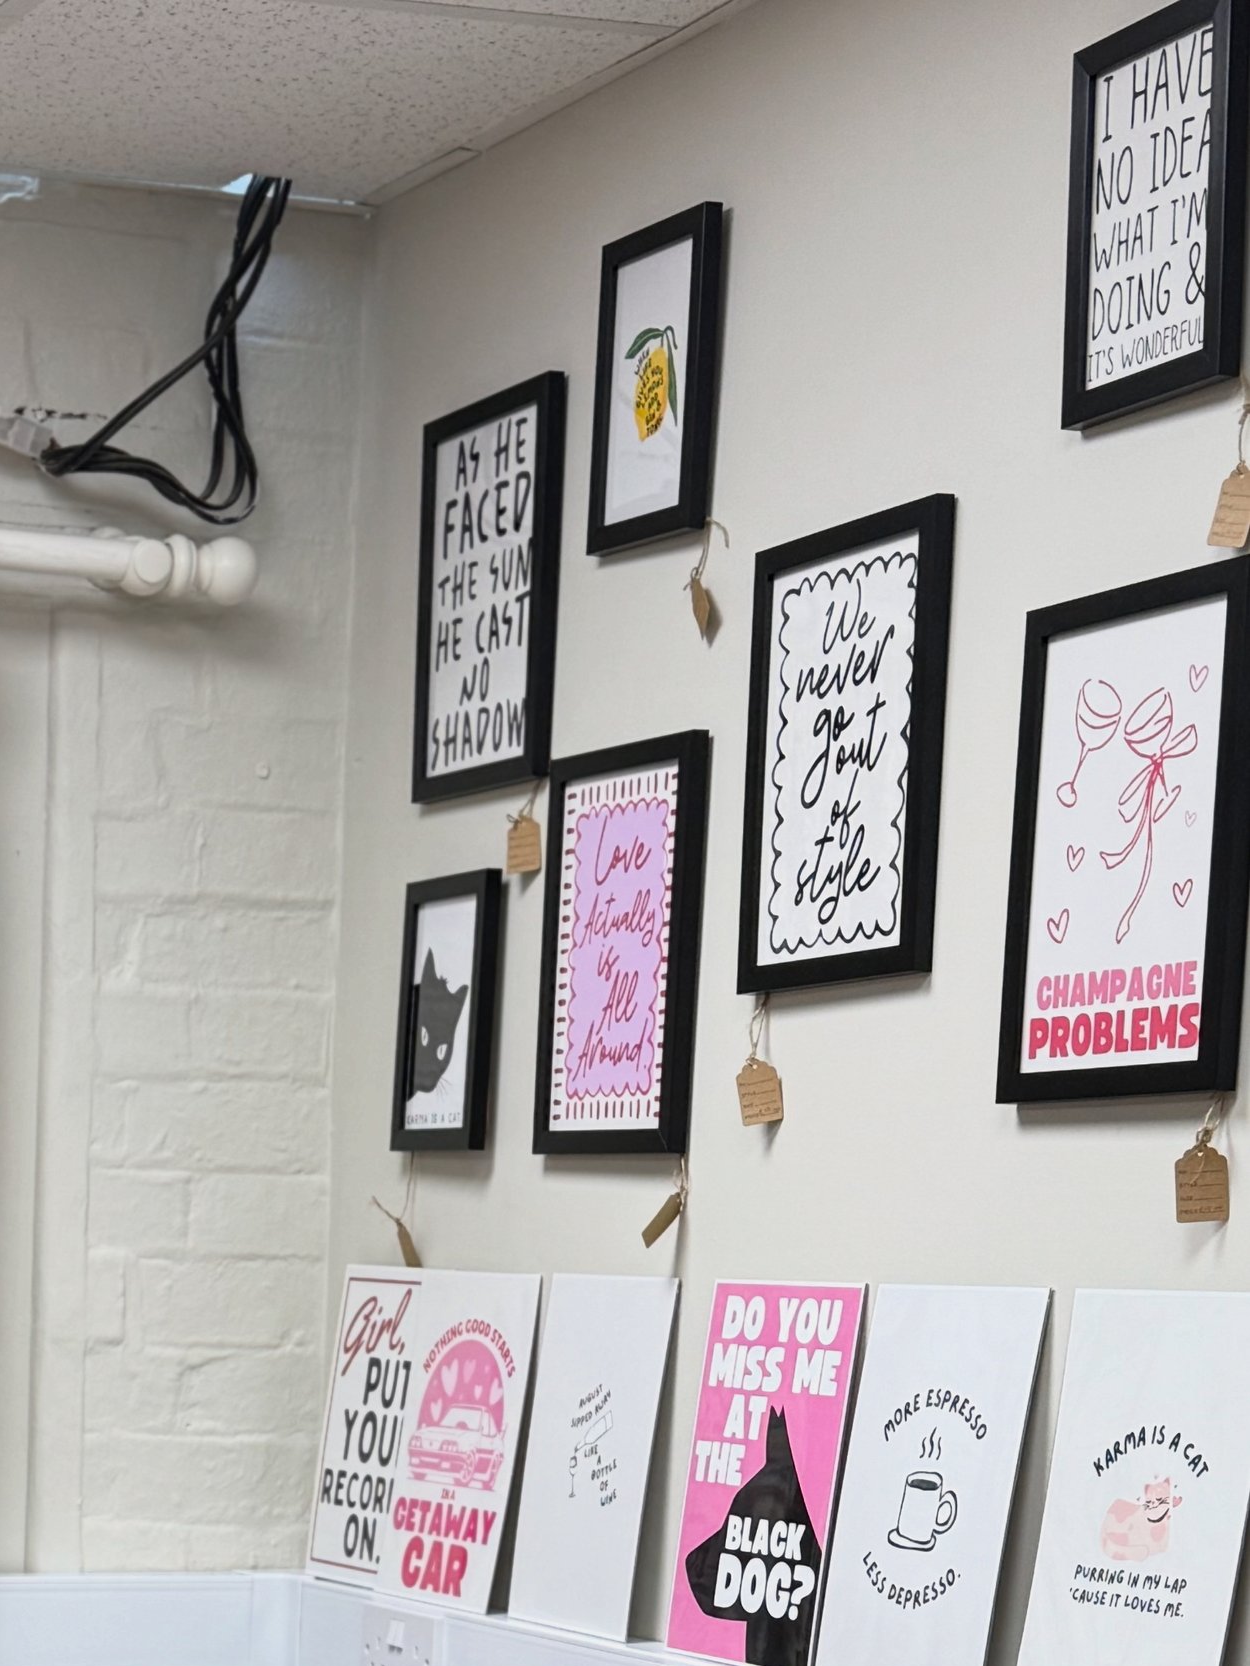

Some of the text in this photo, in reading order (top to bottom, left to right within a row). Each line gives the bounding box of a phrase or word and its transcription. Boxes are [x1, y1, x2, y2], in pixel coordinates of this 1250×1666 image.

[1102, 27, 1213, 143] I HAVE
[1096, 107, 1211, 215] NO IDEA
[1093, 188, 1207, 273] WHAT I'M
[1092, 241, 1205, 341] DOING &
[1087, 316, 1204, 382] IT'S WONDERFUL
[455, 417, 528, 492] AS HE
[443, 471, 531, 559] FACED
[438, 537, 533, 610] THE SUN
[435, 591, 531, 672] HE CAST
[823, 578, 876, 654] We
[459, 657, 490, 706] NO
[796, 624, 895, 702] never
[431, 697, 526, 771] SHADOW
[800, 692, 887, 809] go out
[830, 768, 861, 848] of
[595, 815, 652, 886] Love
[794, 824, 880, 925] style
[579, 889, 656, 949] Actually
[597, 944, 620, 982] is
[1036, 960, 1198, 1011] CHAMPAGNE
[596, 969, 639, 1032] All
[1028, 1002, 1200, 1060] PROBLEMS
[341, 1288, 412, 1377] Girl,
[423, 1319, 516, 1378] NOTHING GOOD STARTS
[721, 1295, 843, 1346] DO YOU
[363, 1357, 412, 1411] PUT
[579, 1384, 602, 1408] AUGUST
[708, 1343, 842, 1397] MISS ME
[343, 1408, 403, 1467] YOU
[723, 1394, 768, 1440] AT
[884, 1388, 987, 1442] MORE ESPRESSO
[584, 1444, 598, 1458] LIKE
[591, 1458, 617, 1480] BOTTLE
[597, 1455, 602, 1465] A
[695, 1440, 746, 1486] THE
[1093, 1425, 1209, 1478] KARMA IS A CAT
[320, 1469, 394, 1514] RECOR
[600, 1480, 608, 1492] OF
[343, 1514, 380, 1564] ON.
[392, 1497, 497, 1545] GETAWAY
[724, 1514, 806, 1561] BLACK
[401, 1536, 468, 1597] CAR
[713, 1552, 816, 1621] DOG?
[862, 1551, 961, 1610] LESS DEPRESSO.
[1074, 1564, 1187, 1595] PURRING IN MY LAP
[1070, 1587, 1184, 1618] 'CAUSE IT LOVES ME.
